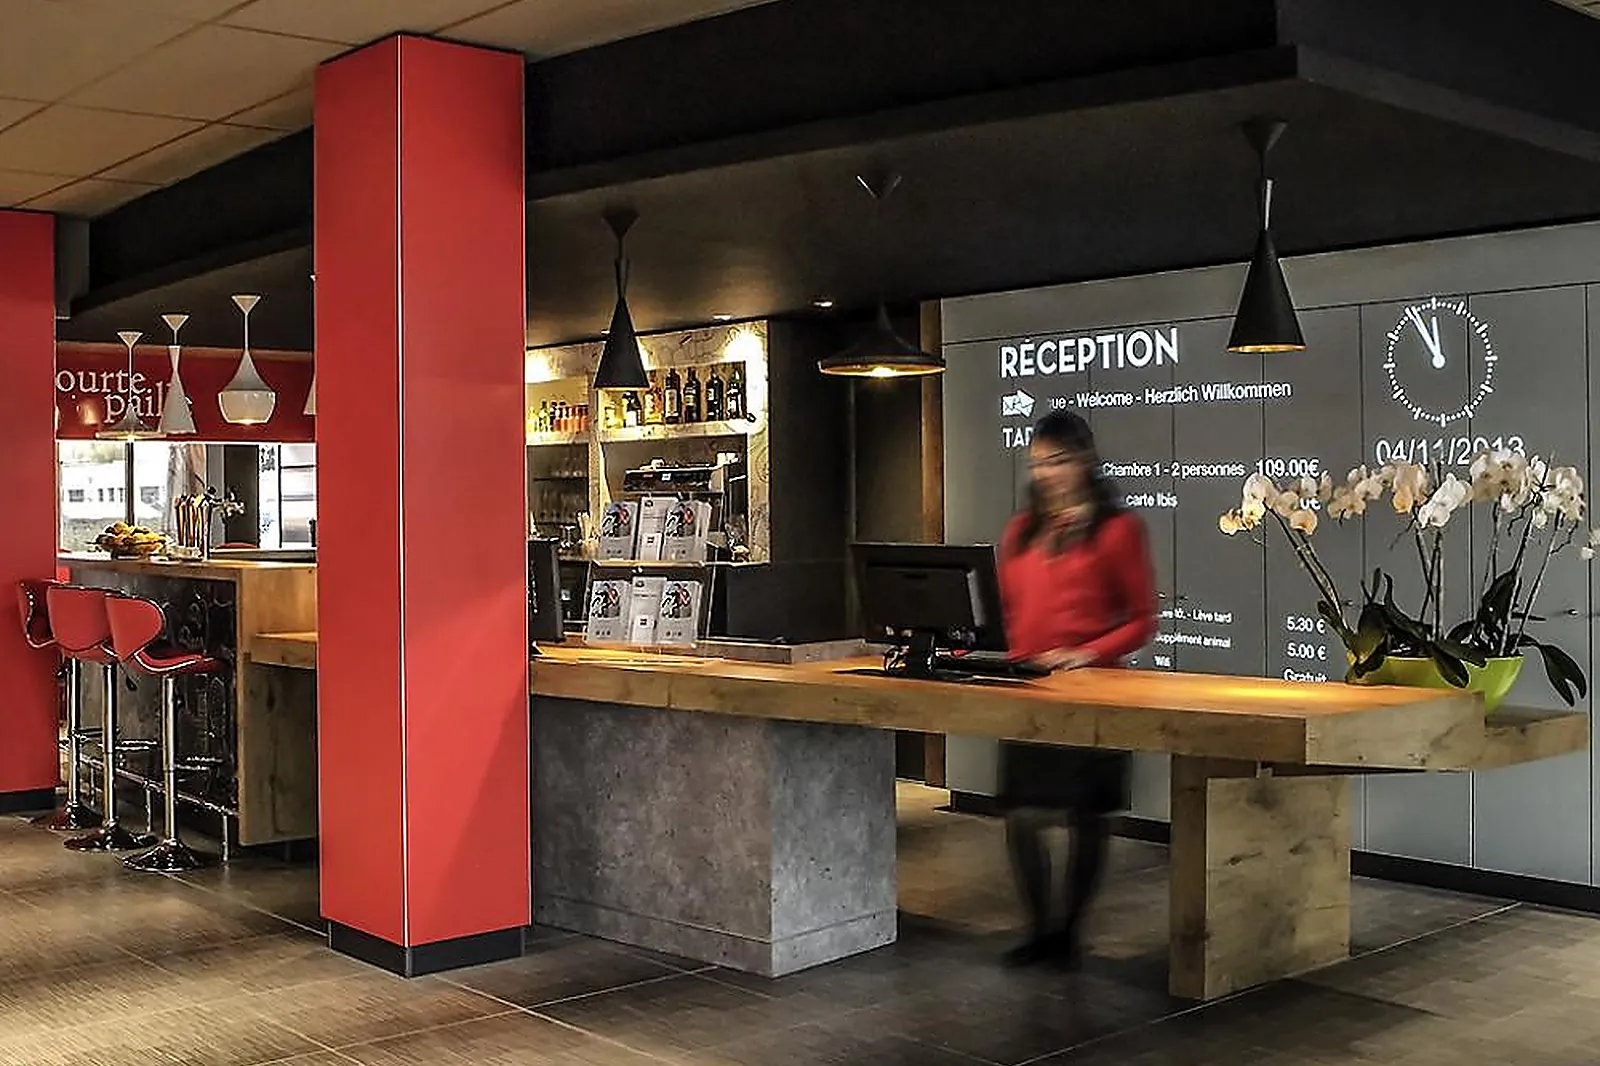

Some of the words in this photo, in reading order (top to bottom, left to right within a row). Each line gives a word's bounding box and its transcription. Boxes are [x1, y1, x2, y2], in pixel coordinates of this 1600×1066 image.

[1001, 327, 1178, 378] RÉCEPTION
[103, 380, 172, 423] pail
[1076, 391, 1134, 408] Welcome
[1145, 385, 1198, 404] Herzlich
[1201, 382, 1292, 401] Willkommen
[1102, 462, 1152, 477] Chambre
[1171, 462, 1180, 476] 2
[1181, 463, 1245, 479] personnes
[1256, 459, 1319, 478] 109.00€
[1316, 619, 1326, 633] €
[1317, 646, 1327, 660] €
